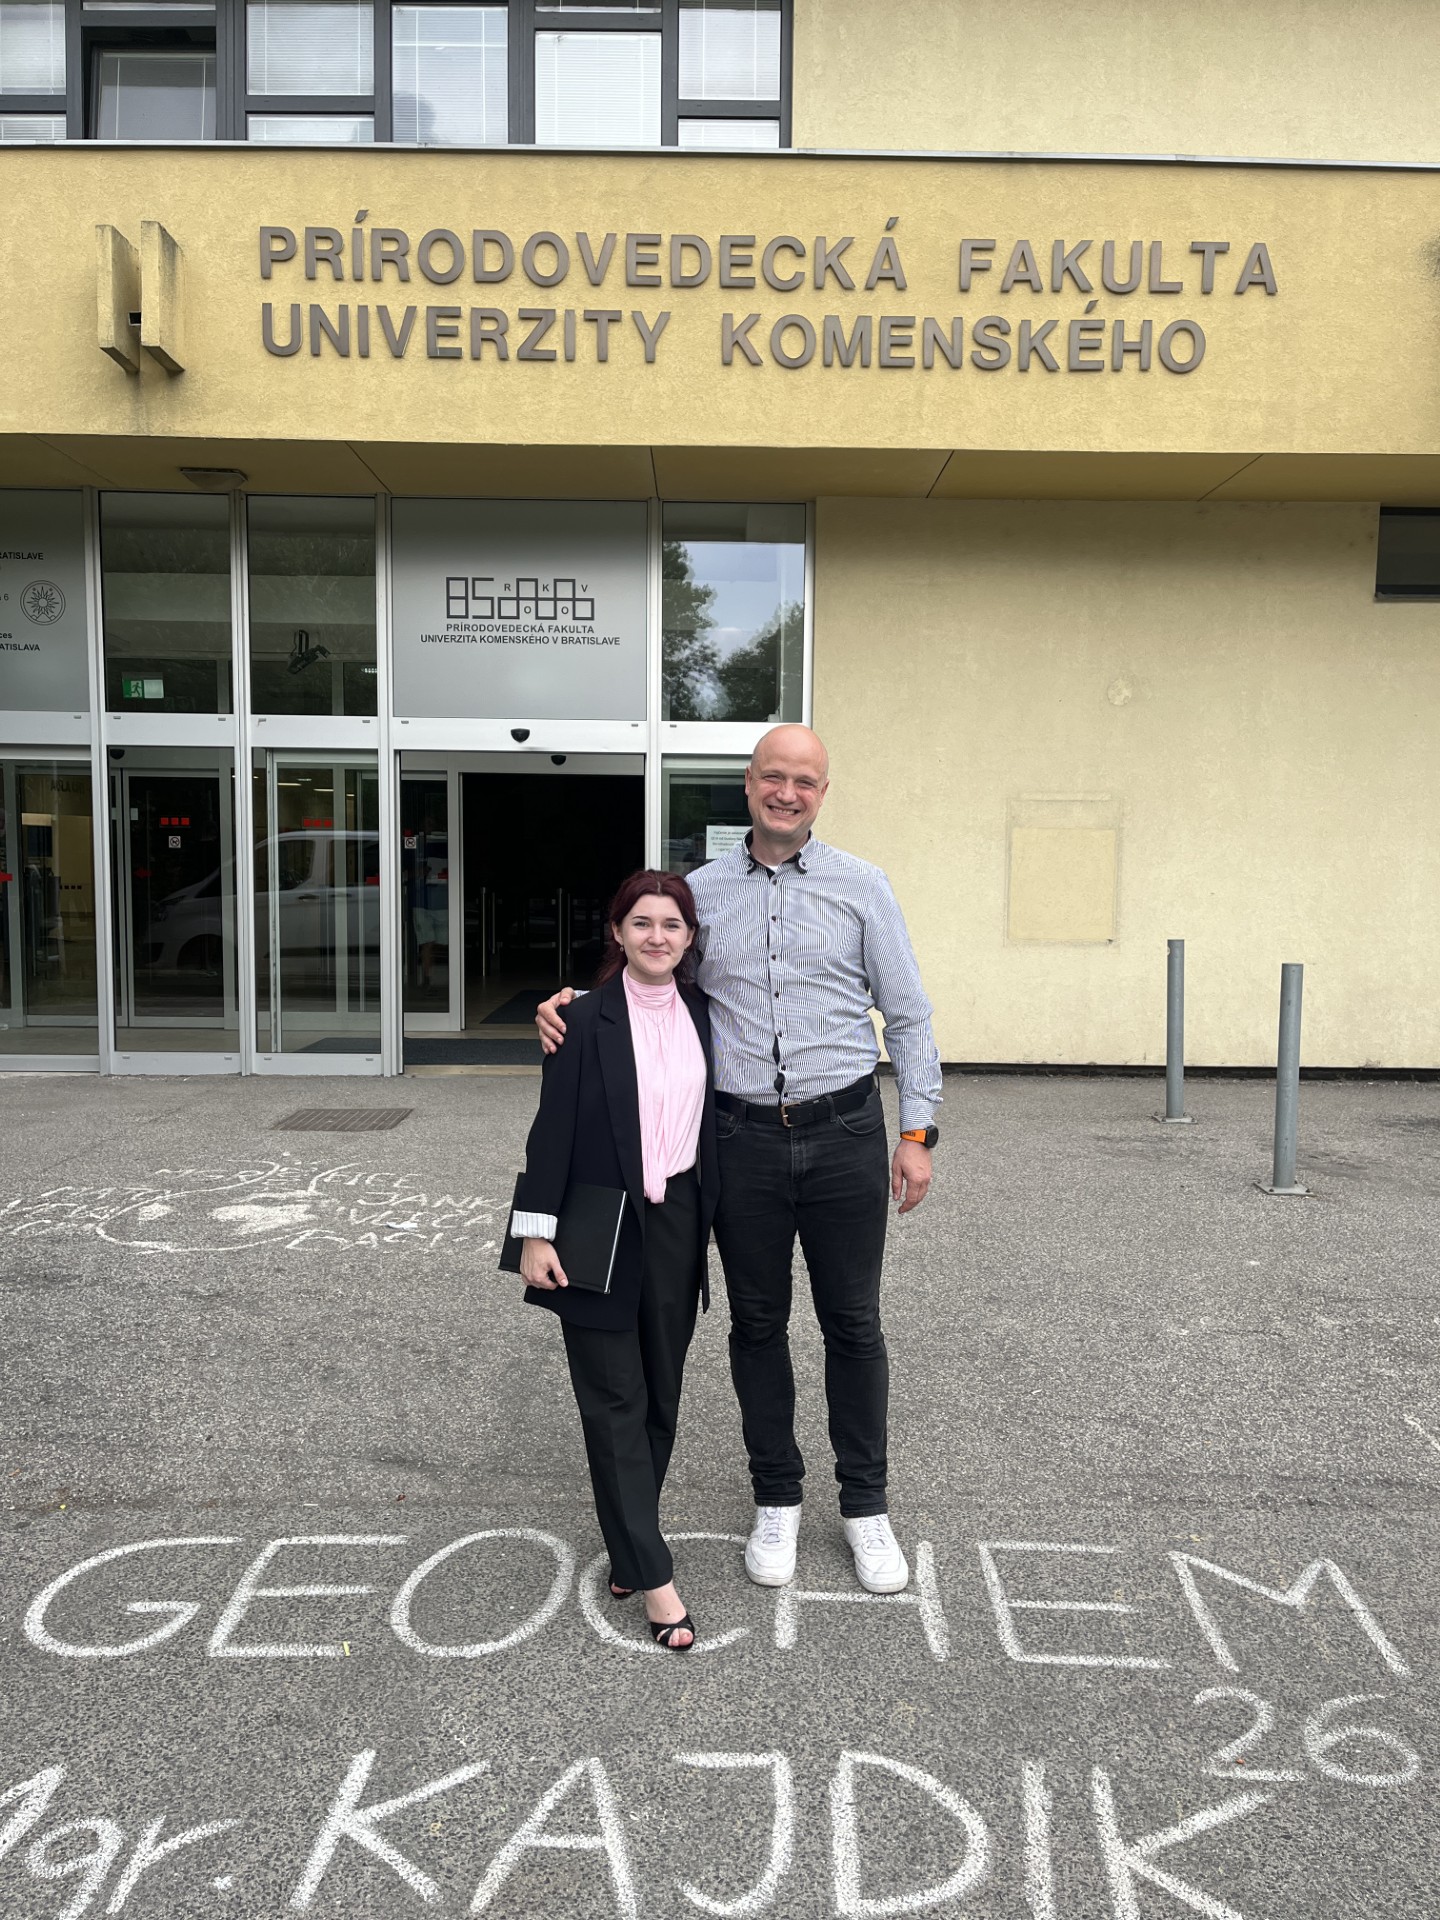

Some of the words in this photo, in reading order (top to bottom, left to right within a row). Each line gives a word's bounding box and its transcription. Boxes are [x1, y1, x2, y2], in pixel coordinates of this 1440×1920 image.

[259, 209, 907, 291] PRÍRODOVEDECKÁ
[959, 238, 1278, 295] FAKULTA
[261, 302, 671, 362] UNIVERZITY
[721, 300, 1206, 373] KOMENSKÉHO
[421, 634, 477, 644] UNIVERZITA
[479, 634, 550, 645] KOMENSKÉHO
[552, 636, 559, 645] V
[561, 636, 621, 646] BRATISLAVE
[446, 622, 545, 633] PRÍRODOVEDECKÁ
[548, 625, 595, 633] FAKULTA
[354, 1191, 515, 1210] JANK
[23, 1526, 1410, 1676] GEOCHEM
[1193, 1685, 1420, 1786] 26
[288, 1748, 1275, 1920] KAJDIK
